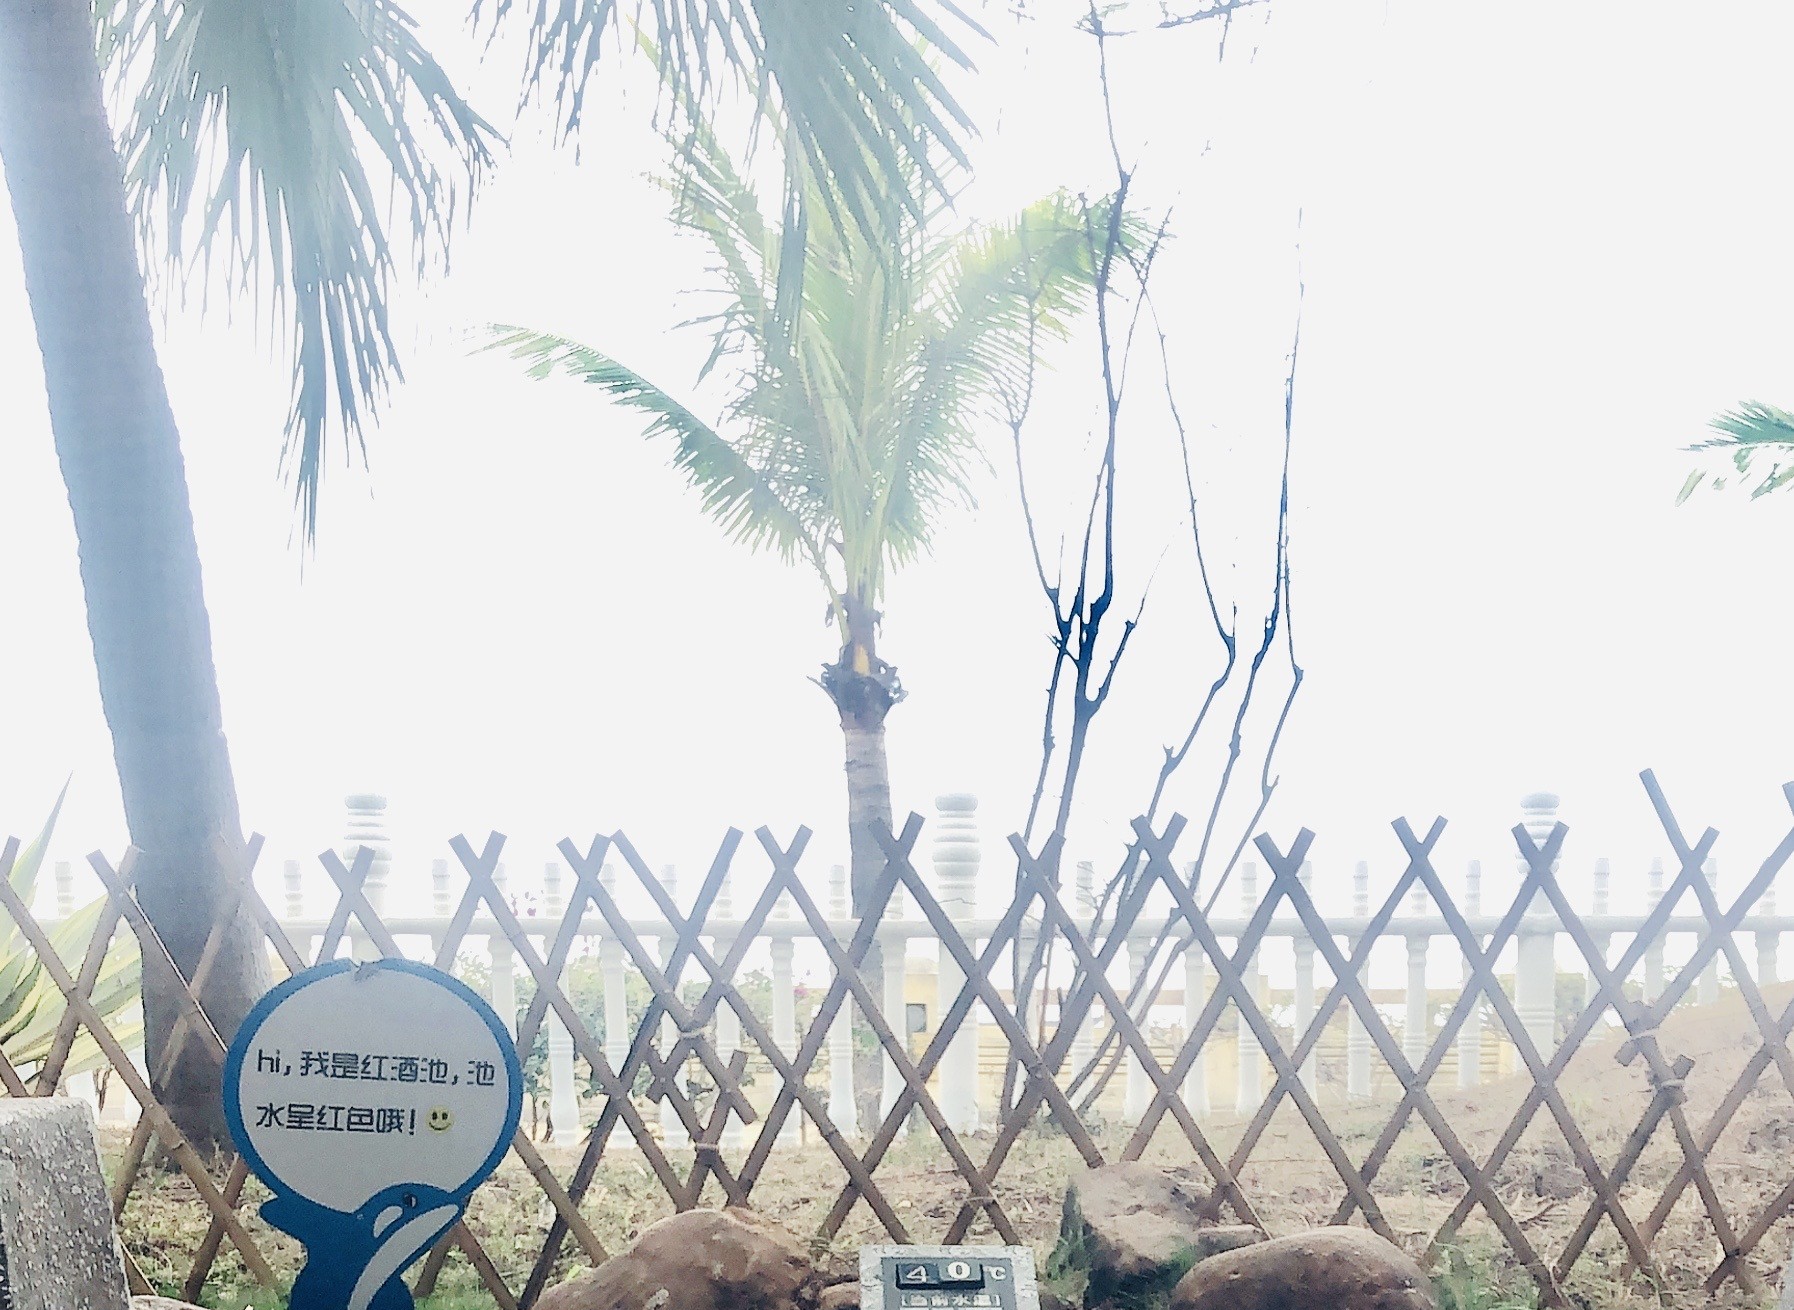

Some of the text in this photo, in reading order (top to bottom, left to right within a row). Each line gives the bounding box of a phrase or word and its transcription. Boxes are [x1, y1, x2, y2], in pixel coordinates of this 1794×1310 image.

[256, 1102, 416, 1135] 水呈红色哦!
